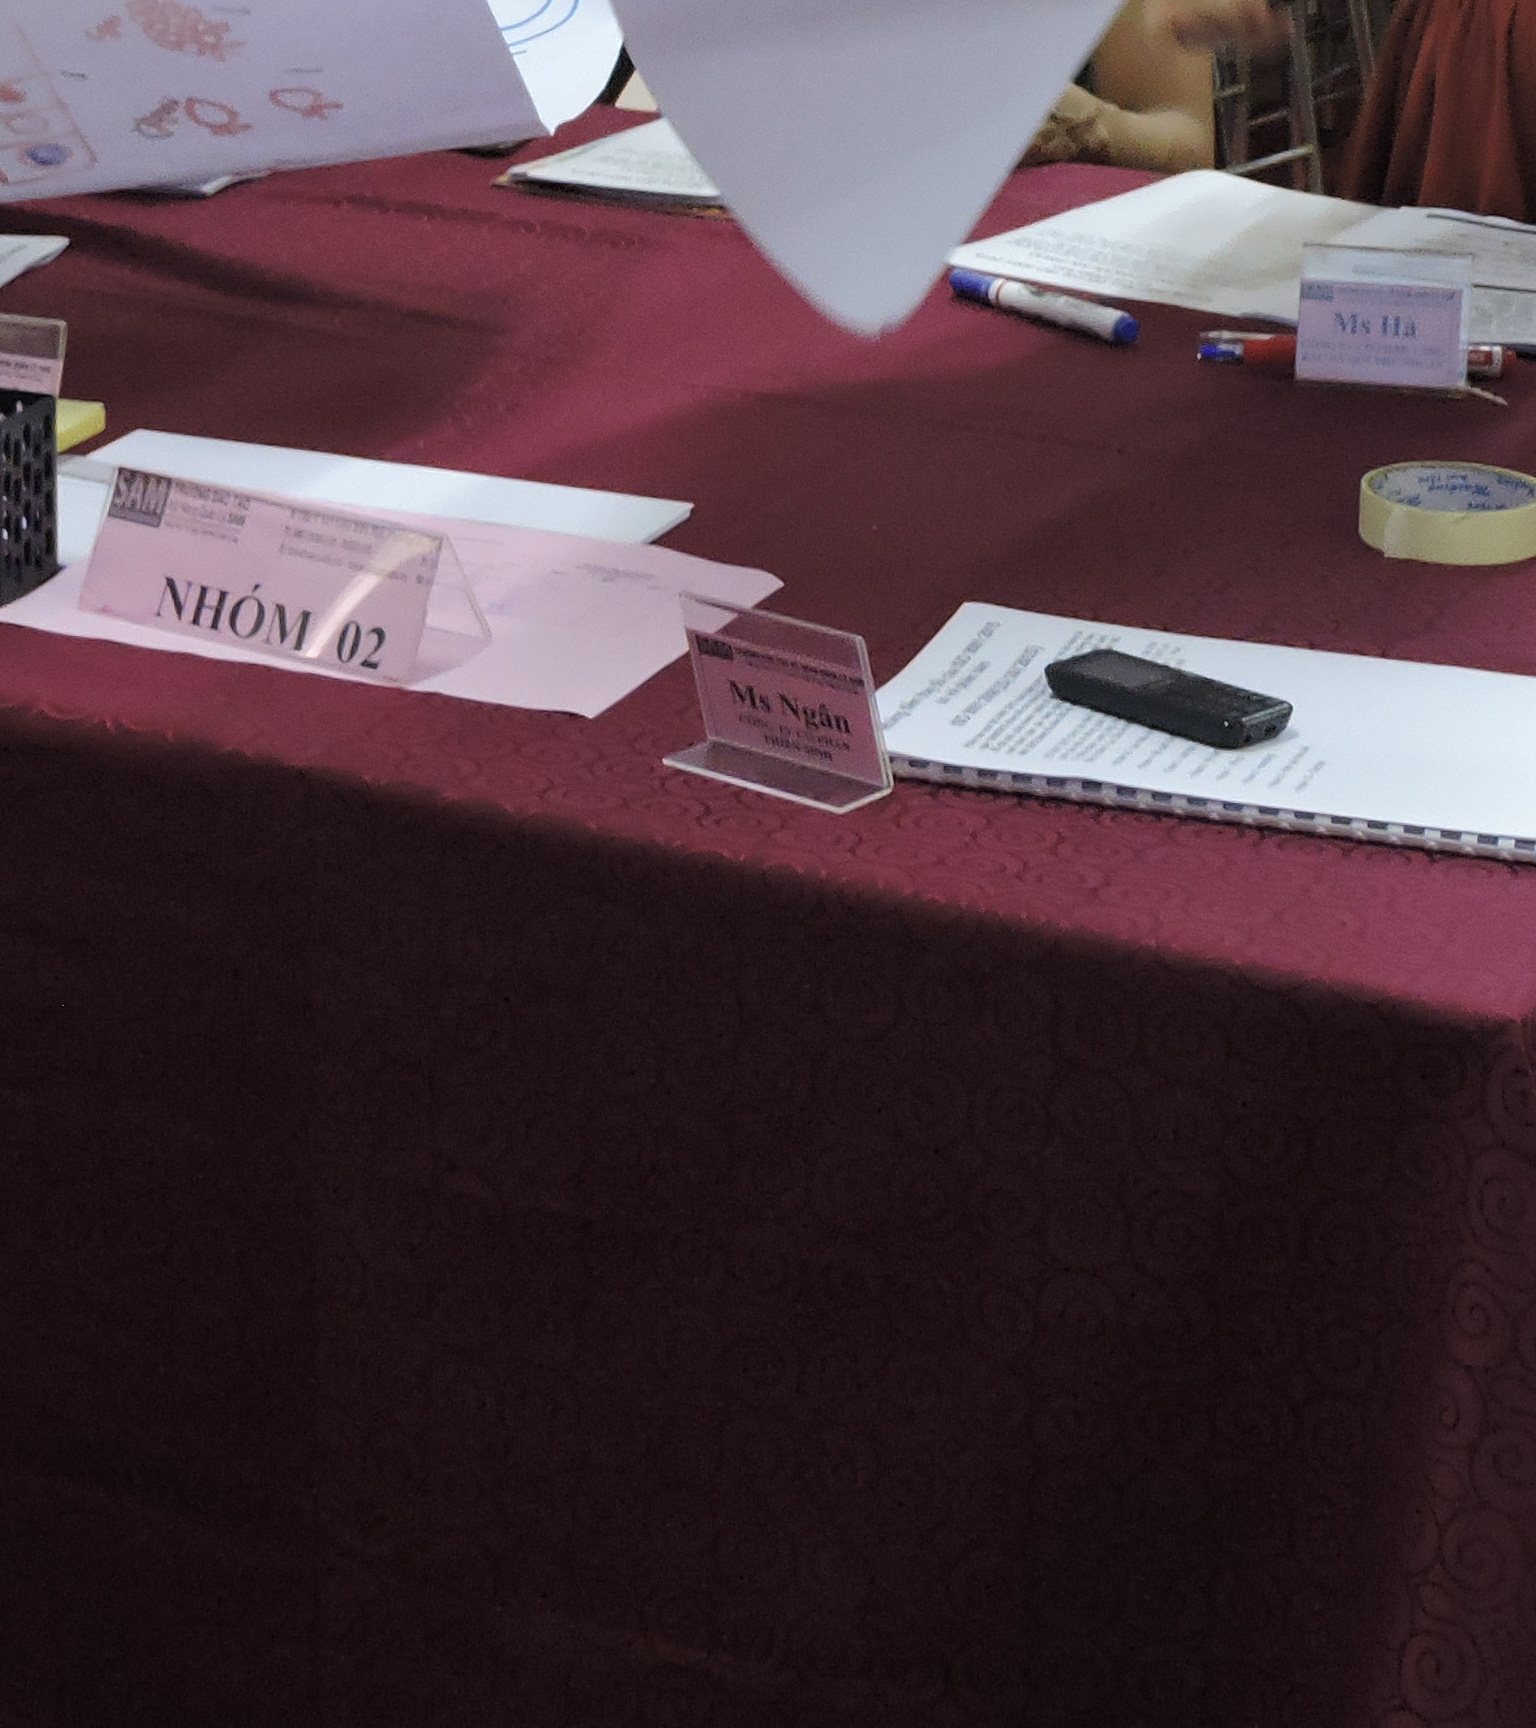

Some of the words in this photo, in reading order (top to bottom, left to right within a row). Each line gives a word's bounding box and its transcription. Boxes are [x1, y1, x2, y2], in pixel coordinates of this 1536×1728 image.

[1333, 311, 1371, 337] Ms
[112, 468, 171, 515] SAM
[154, 576, 313, 652] NHÓM
[335, 618, 387, 670] 02
[727, 679, 771, 713] Ms
[776, 691, 852, 734] Ngân
